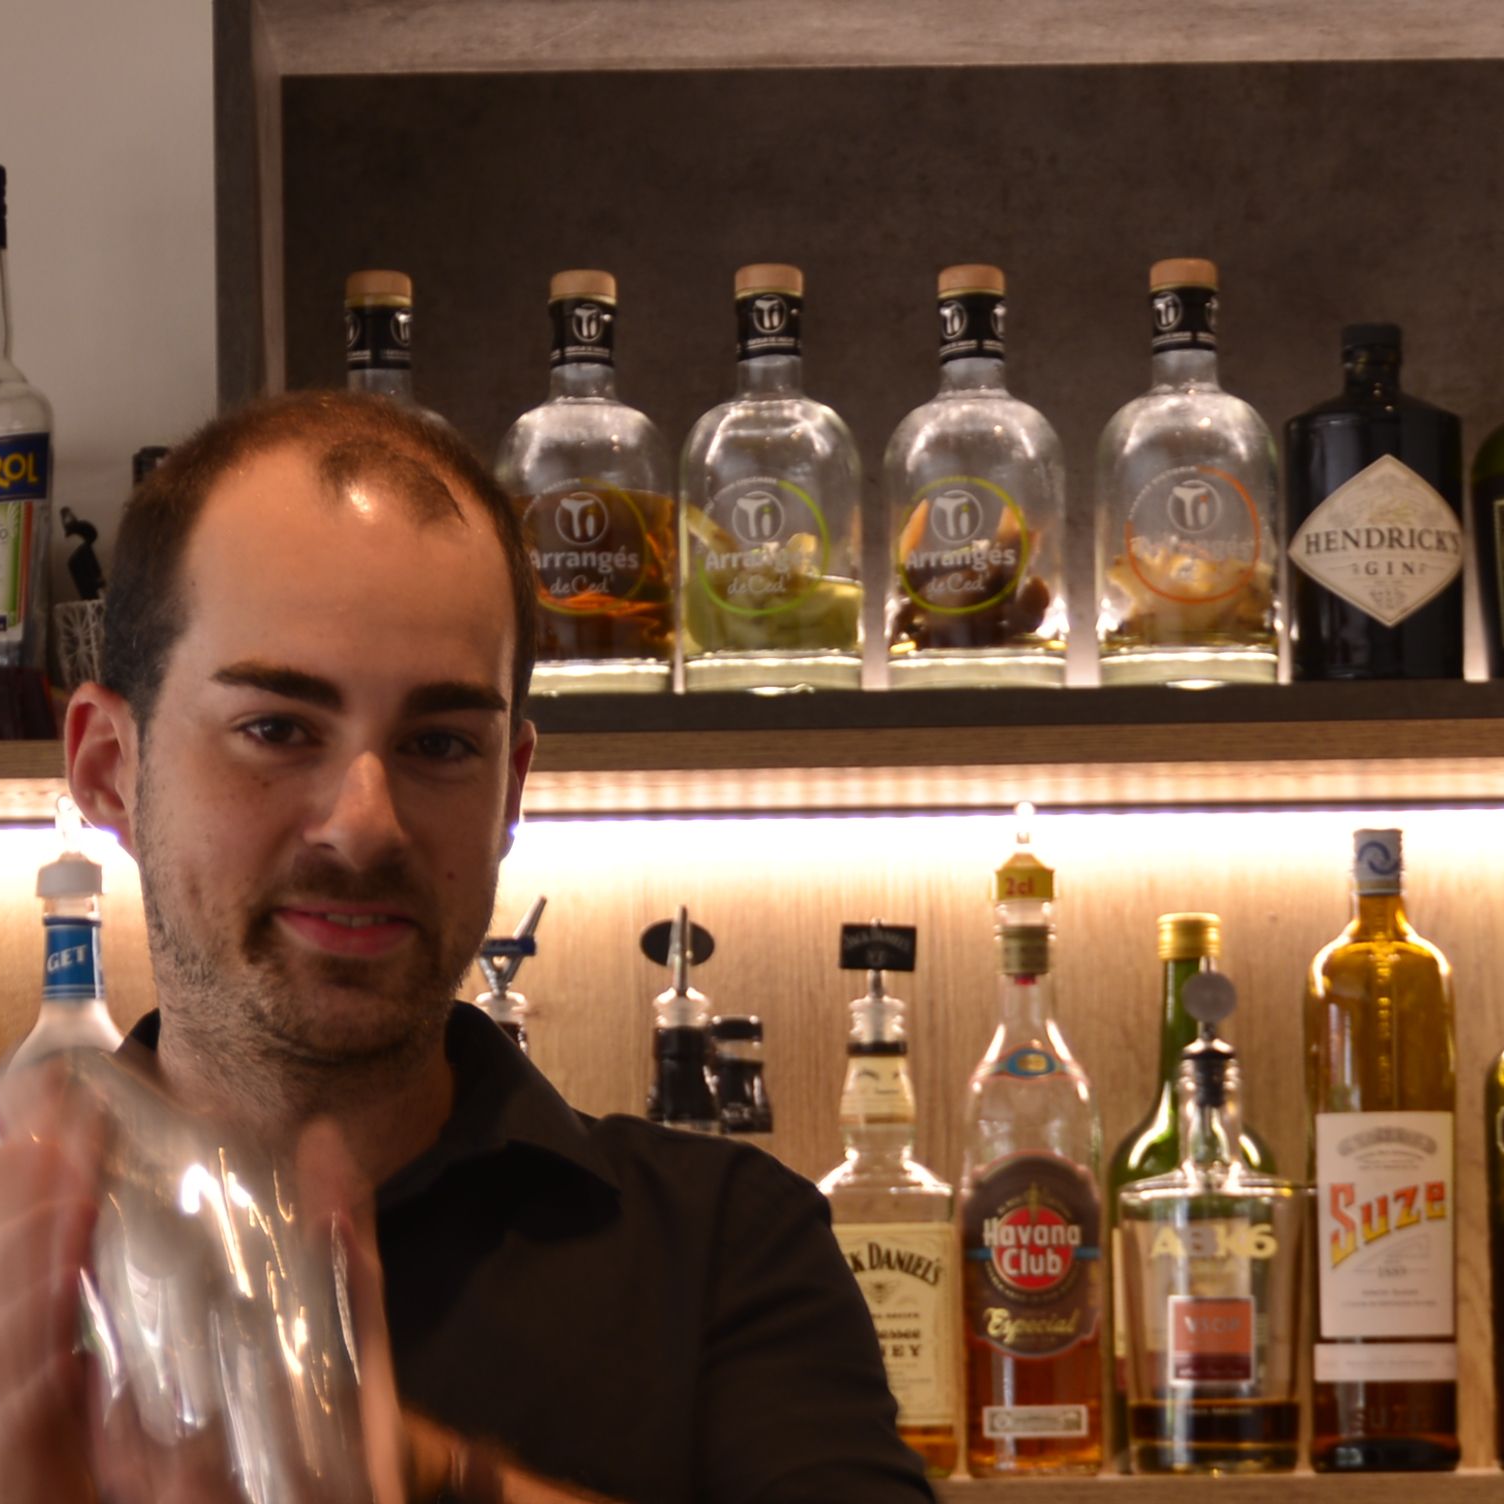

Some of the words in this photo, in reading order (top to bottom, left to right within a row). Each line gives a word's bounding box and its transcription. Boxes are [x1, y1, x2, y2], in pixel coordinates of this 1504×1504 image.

[529, 545, 639, 574] Arrangés
[906, 544, 1016, 571] Arrangés
[1364, 561, 1416, 576] GIN
[1006, 876, 1035, 896] 2cl
[47, 944, 88, 974] GET
[983, 1217, 1082, 1247] Havana
[1329, 1181, 1446, 1269] Suze
[1151, 1223, 1279, 1260] ABK6
[868, 1242, 943, 1287] DANIEL'S
[1002, 1248, 1063, 1276] Club
[984, 1307, 1081, 1345] Especial
